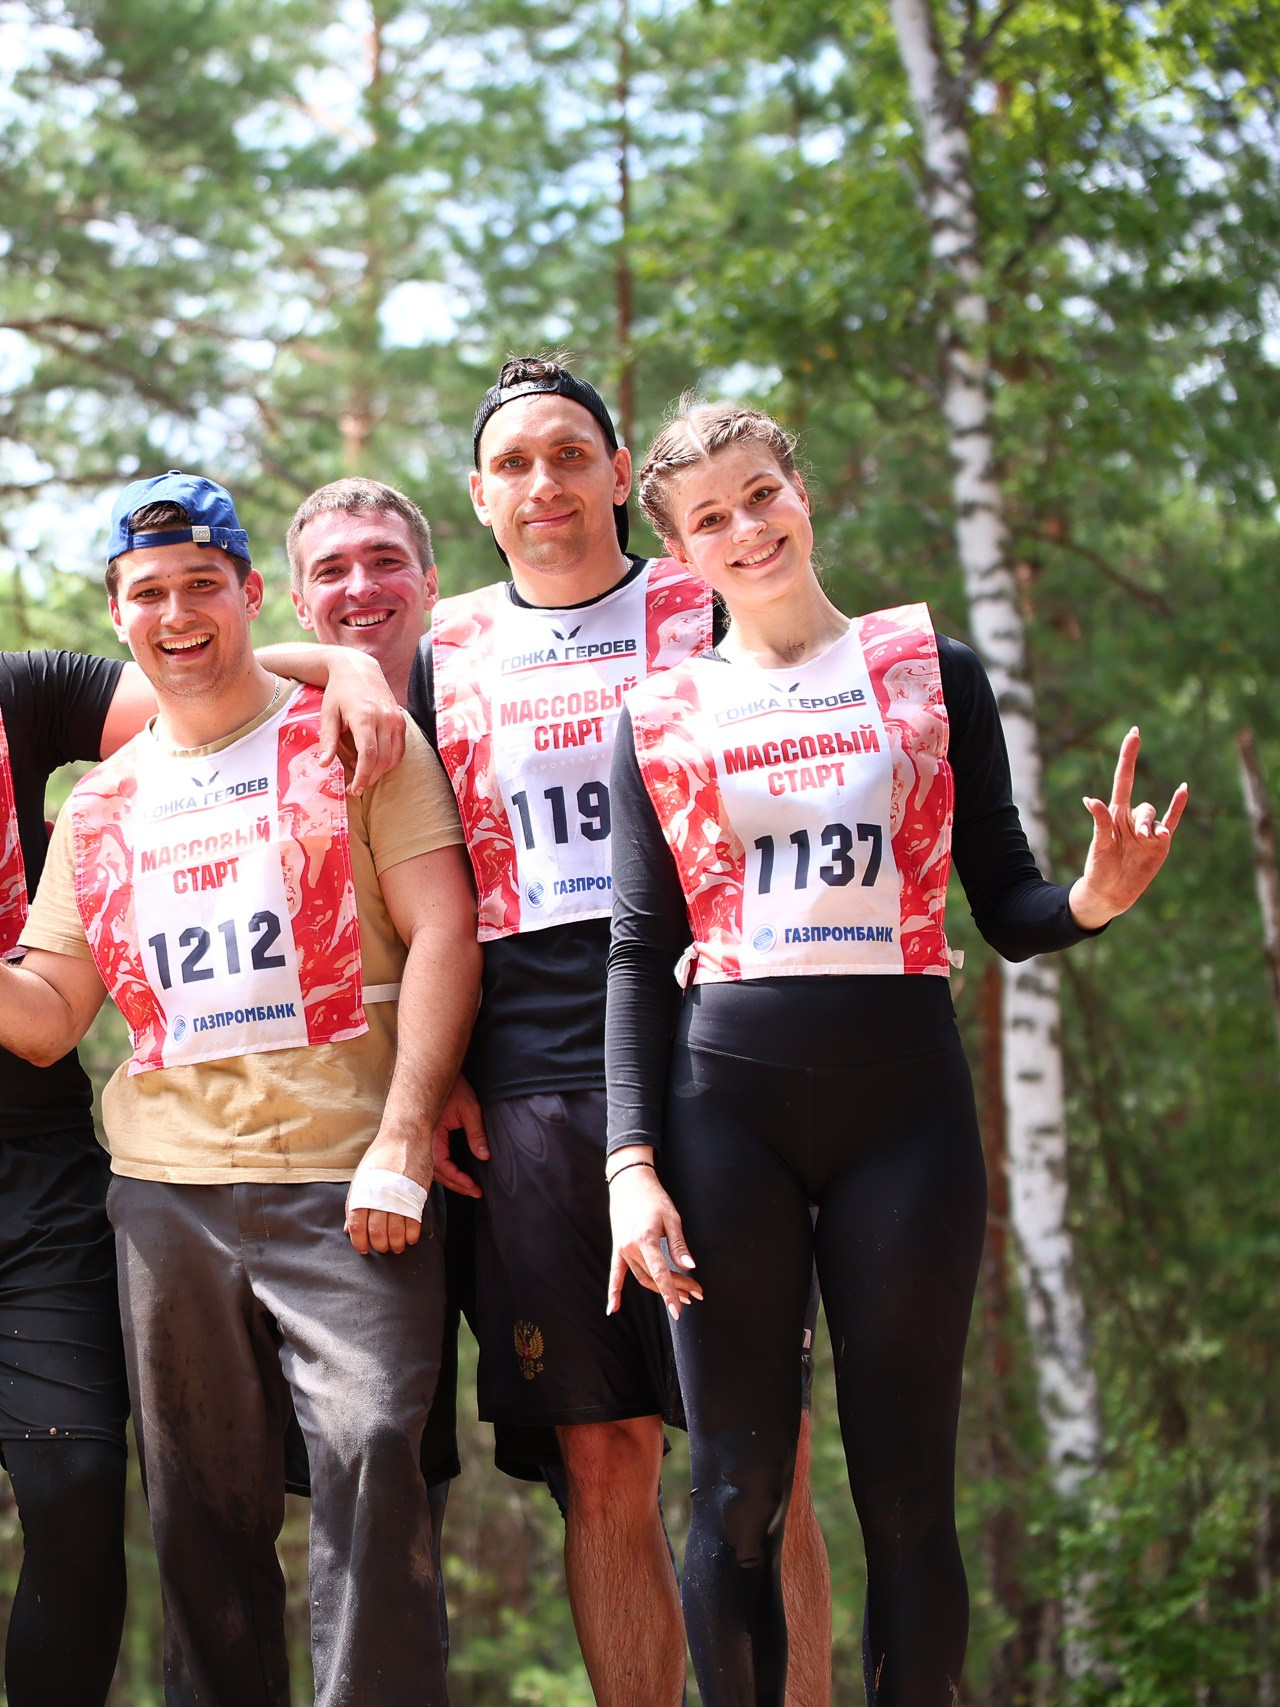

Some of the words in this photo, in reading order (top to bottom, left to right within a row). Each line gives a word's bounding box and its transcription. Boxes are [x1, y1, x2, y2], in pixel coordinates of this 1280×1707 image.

[501, 648, 558, 671] ГОНКА
[564, 638, 637, 659] ГЕРОЕВ
[714, 698, 781, 723] ГОНКА
[787, 689, 865, 709] ГЕРОЕВ
[534, 717, 604, 752] СТАРТ
[723, 724, 881, 775] МАССОВЫЙ
[204, 777, 268, 805] ГЕРОЕВ
[767, 762, 845, 796] СТАРТ
[510, 780, 612, 850] 119
[141, 815, 270, 873] МАССОВЫЙ
[754, 823, 883, 895] 1137
[173, 857, 240, 895] СТАРТ
[149, 910, 286, 991] 1212
[785, 926, 894, 944] ГАЗПРОМБАНК
[192, 1003, 297, 1033] ГАЗПРОМБАНК
